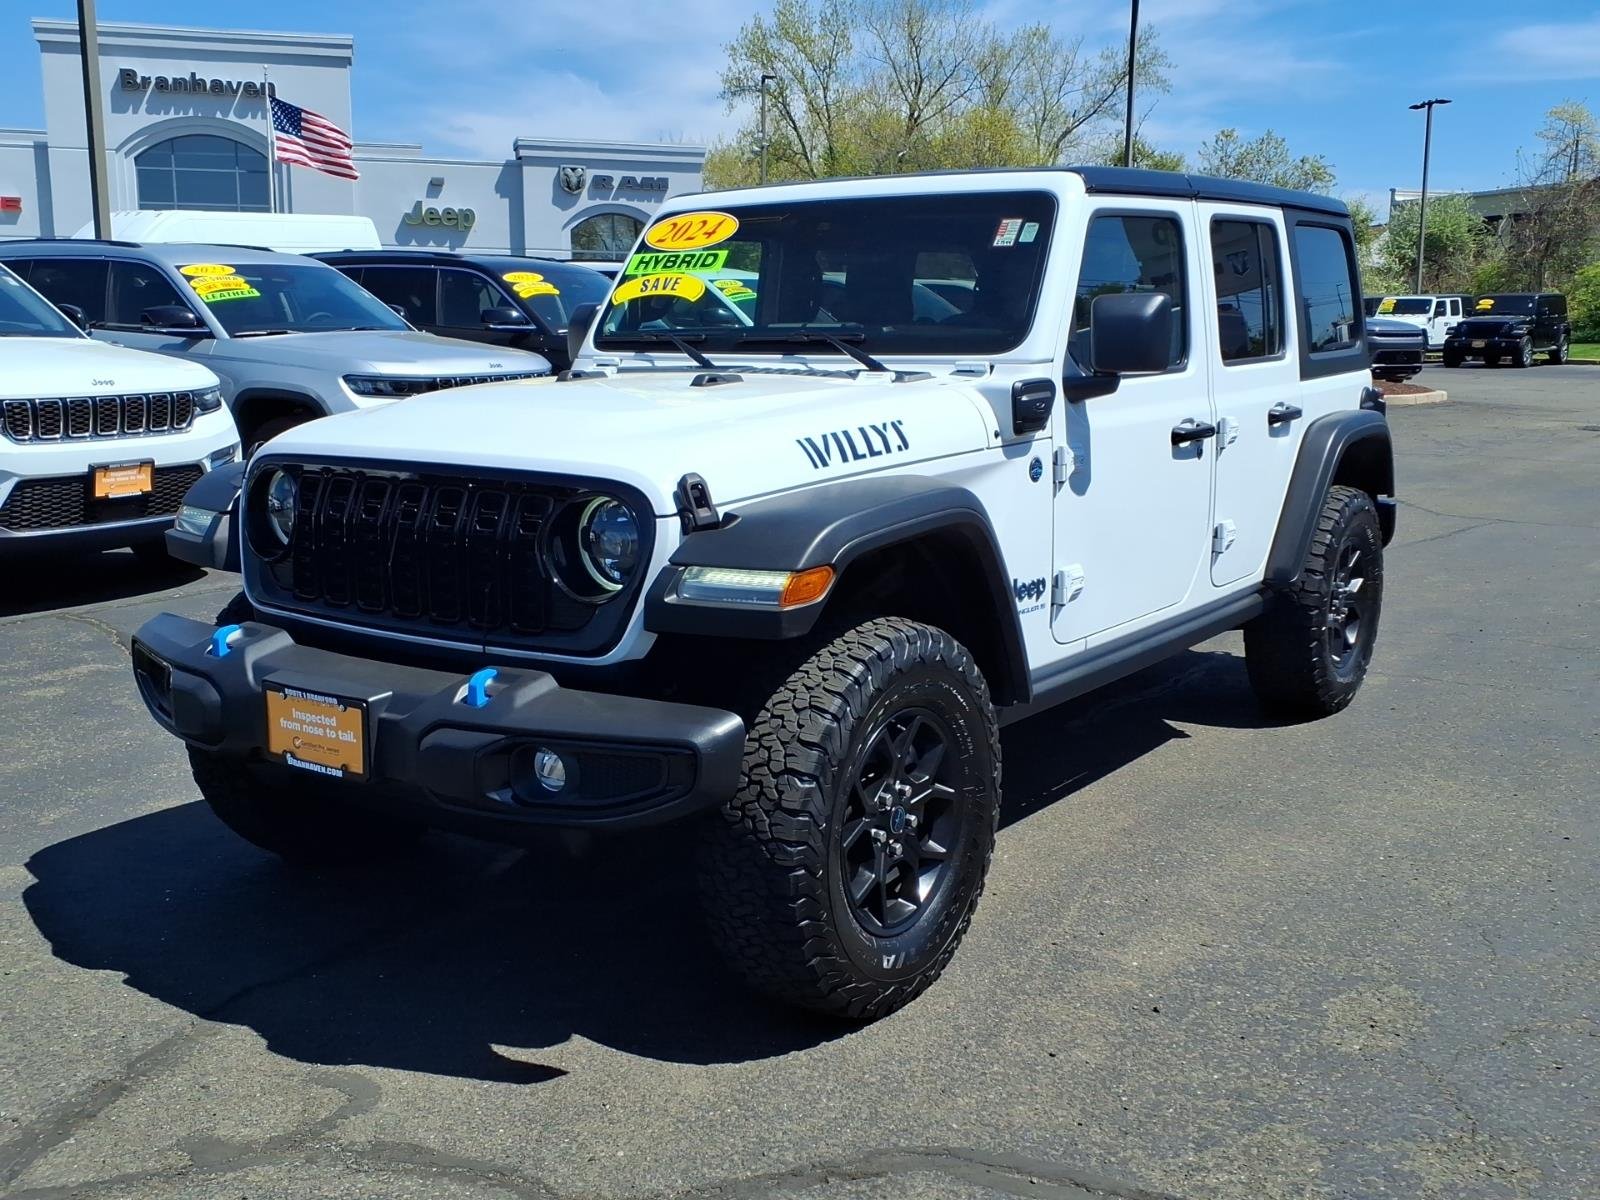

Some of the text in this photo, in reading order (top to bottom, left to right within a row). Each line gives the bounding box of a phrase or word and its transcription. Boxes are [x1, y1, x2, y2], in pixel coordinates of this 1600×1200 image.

[120, 68, 276, 98] Branhaven
[591, 174, 669, 192] RAM
[405, 200, 476, 232] Jeep
[655, 217, 728, 243] 2024
[634, 253, 720, 271] HYBRID
[205, 290, 255, 300] LEATHER
[640, 277, 682, 292] SAVE
[795, 420, 910, 470] WILLYS
[292, 707, 337, 727] Inspected
[280, 717, 357, 743] from nose to tail.
